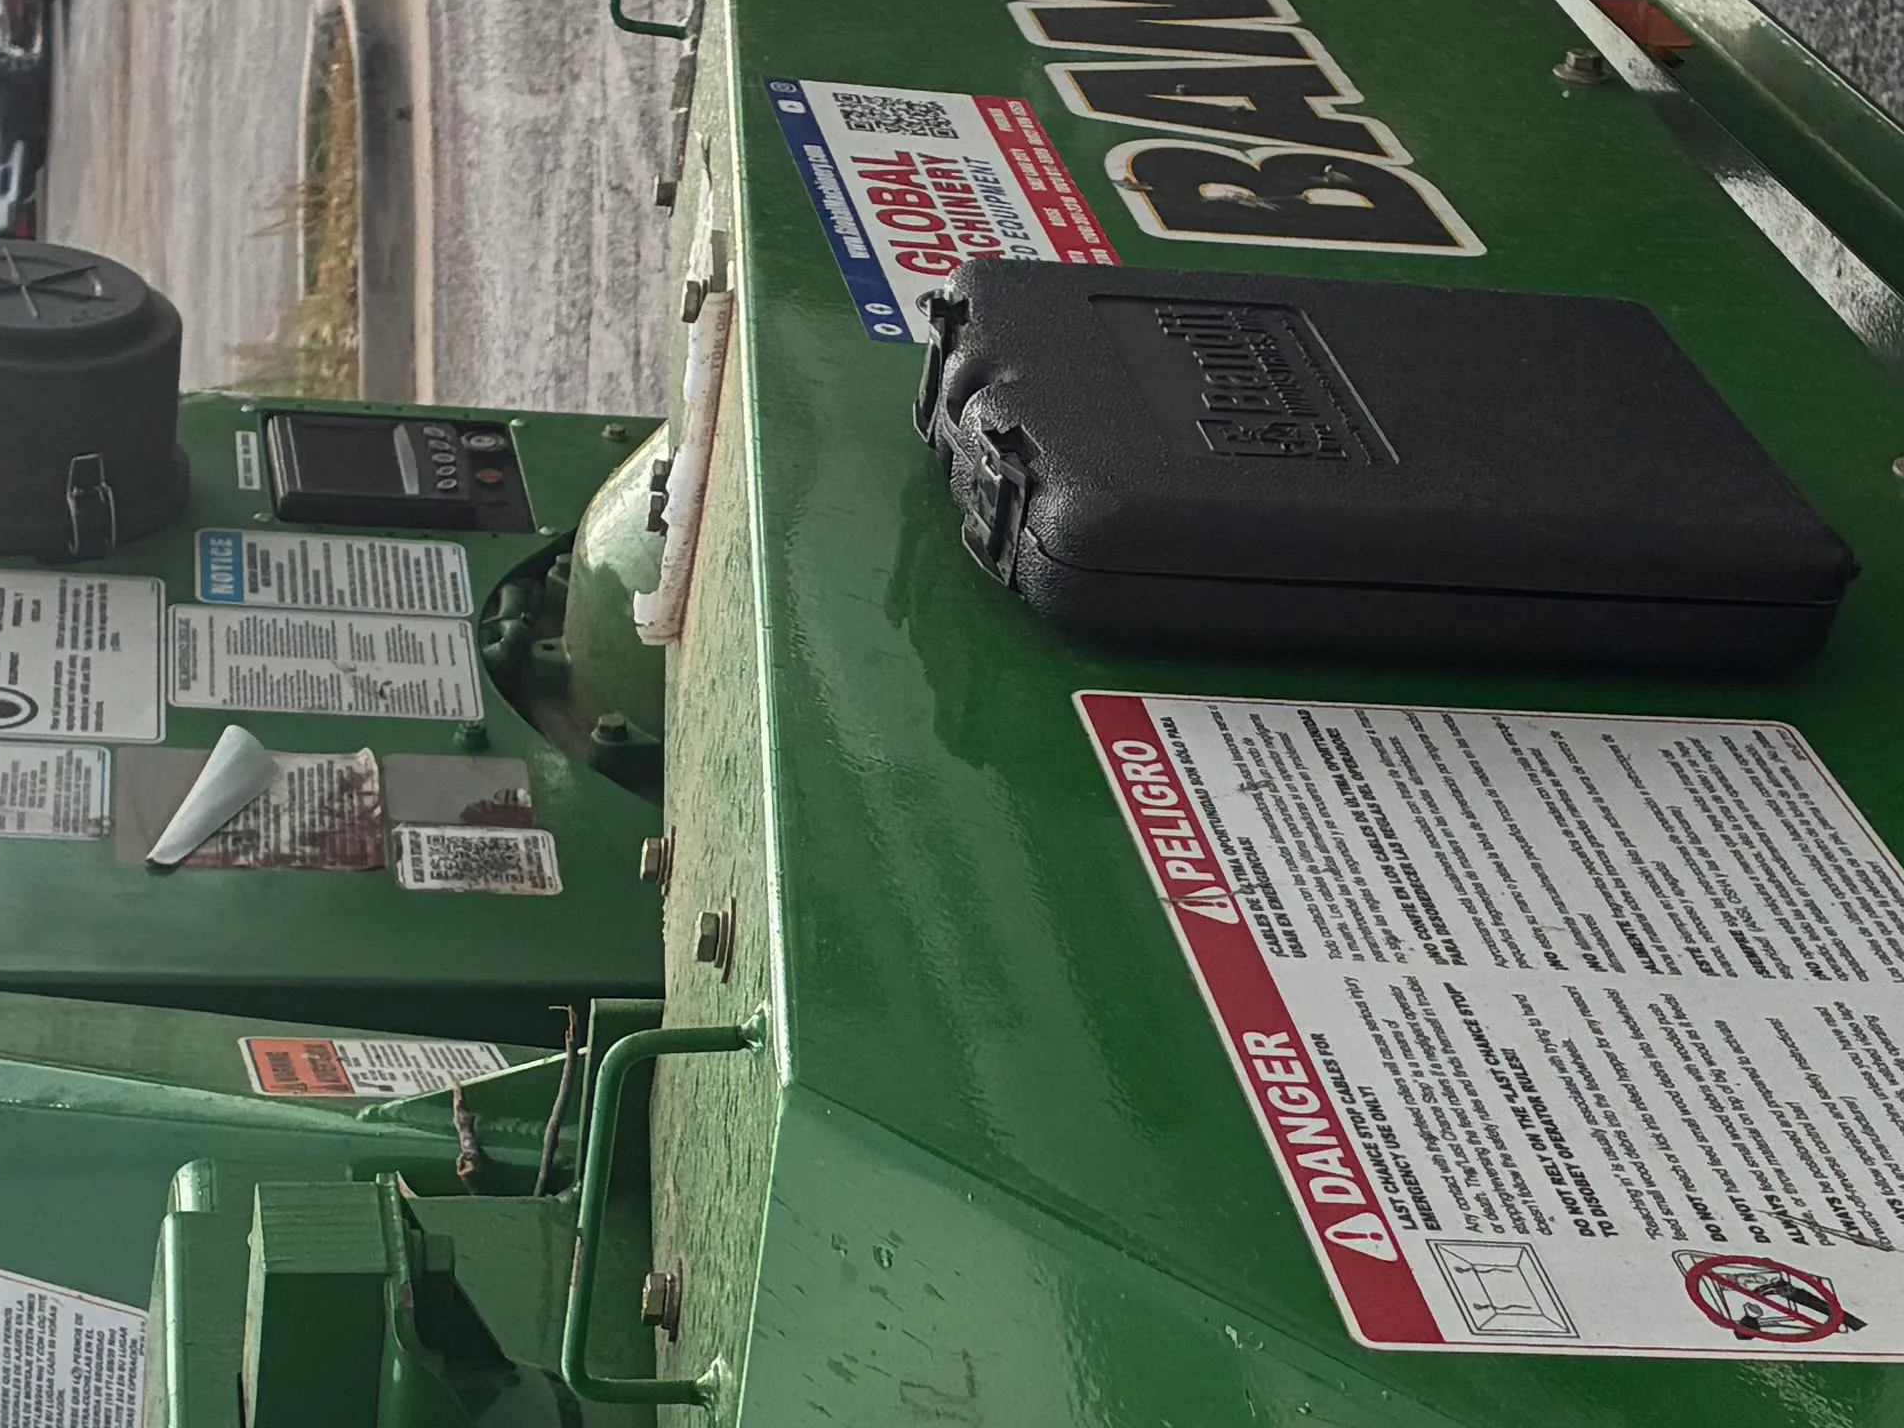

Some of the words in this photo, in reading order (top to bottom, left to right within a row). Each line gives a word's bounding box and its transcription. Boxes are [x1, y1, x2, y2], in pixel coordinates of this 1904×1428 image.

[916, 152, 1006, 260] ACHINERY
[964, 156, 1031, 240] EQUIPMENT
[850, 150, 961, 276] GLOBAL
[1154, 307, 1282, 414] Bandit
[210, 537, 234, 594] NOTICE
[1158, 717, 1182, 739] PARA
[1182, 767, 1204, 786] SON
[1354, 783, 1377, 801] DEL
[1109, 739, 1214, 881] PELIGRO
[1192, 789, 1238, 855] OPORTUNIDAD
[1350, 811, 1369, 822] DE
[1365, 803, 1399, 840] REGLAS
[1358, 826, 1391, 862] CABLES
[1386, 843, 1410, 861] LAS
[1379, 865, 1403, 884] LOS
[1244, 898, 1265, 911] DE
[1391, 887, 1412, 900] EN
[1398, 863, 1451, 936] DESOBEDECER
[1272, 913, 1293, 927] EN
[1280, 930, 1308, 959] USAR
[1439, 939, 1468, 966] PARA
[1584, 1019, 1607, 1036] any
[1813, 1007, 1840, 1027] read
[1309, 1033, 1334, 1056] FOR
[1463, 1020, 1501, 1066] CHANCE
[1592, 1038, 1612, 1049] for
[1828, 1029, 1856, 1051] have
[1599, 1051, 1635, 1082] hopper
[1847, 1053, 1872, 1069] you
[1322, 1059, 1358, 1104] CABLES
[1801, 1073, 1836, 1100] safety
[1857, 1071, 1891, 1101] unless
[1357, 1086, 1388, 1121] ONLY!
[1619, 1084, 1650, 1111] infeed
[1820, 1102, 1846, 1120] and
[1239, 1030, 1365, 1204] DANGER
[1345, 1108, 1374, 1139] STOP
[1509, 1107, 1536, 1129] THE
[1525, 1096, 1575, 1159] OPERATOR
[1637, 1114, 1661, 1131] into
[1375, 1125, 1402, 1149] USE
[1524, 1134, 1548, 1151] ON
[1648, 1133, 1673, 1151] kick
[1833, 1122, 1880, 1166] operation
[1361, 1143, 1401, 1194] CHANCE
[1537, 1156, 1567, 1185] RELY
[1664, 1154, 1681, 1163] or
[1389, 1153, 1442, 1231] EMERGENCY
[1563, 1164, 1608, 1217] DISOBEY
[1667, 1165, 1698, 1192] reach
[1864, 1168, 1897, 1196] follow
[1388, 1198, 1418, 1230] LAST
[1555, 1189, 1583, 1215] NOT
[1685, 1194, 1715, 1221] NOT
[1571, 1219, 1595, 1237] DO
[1596, 1222, 1619, 1238] TO
[1702, 1225, 1728, 1242] DO
